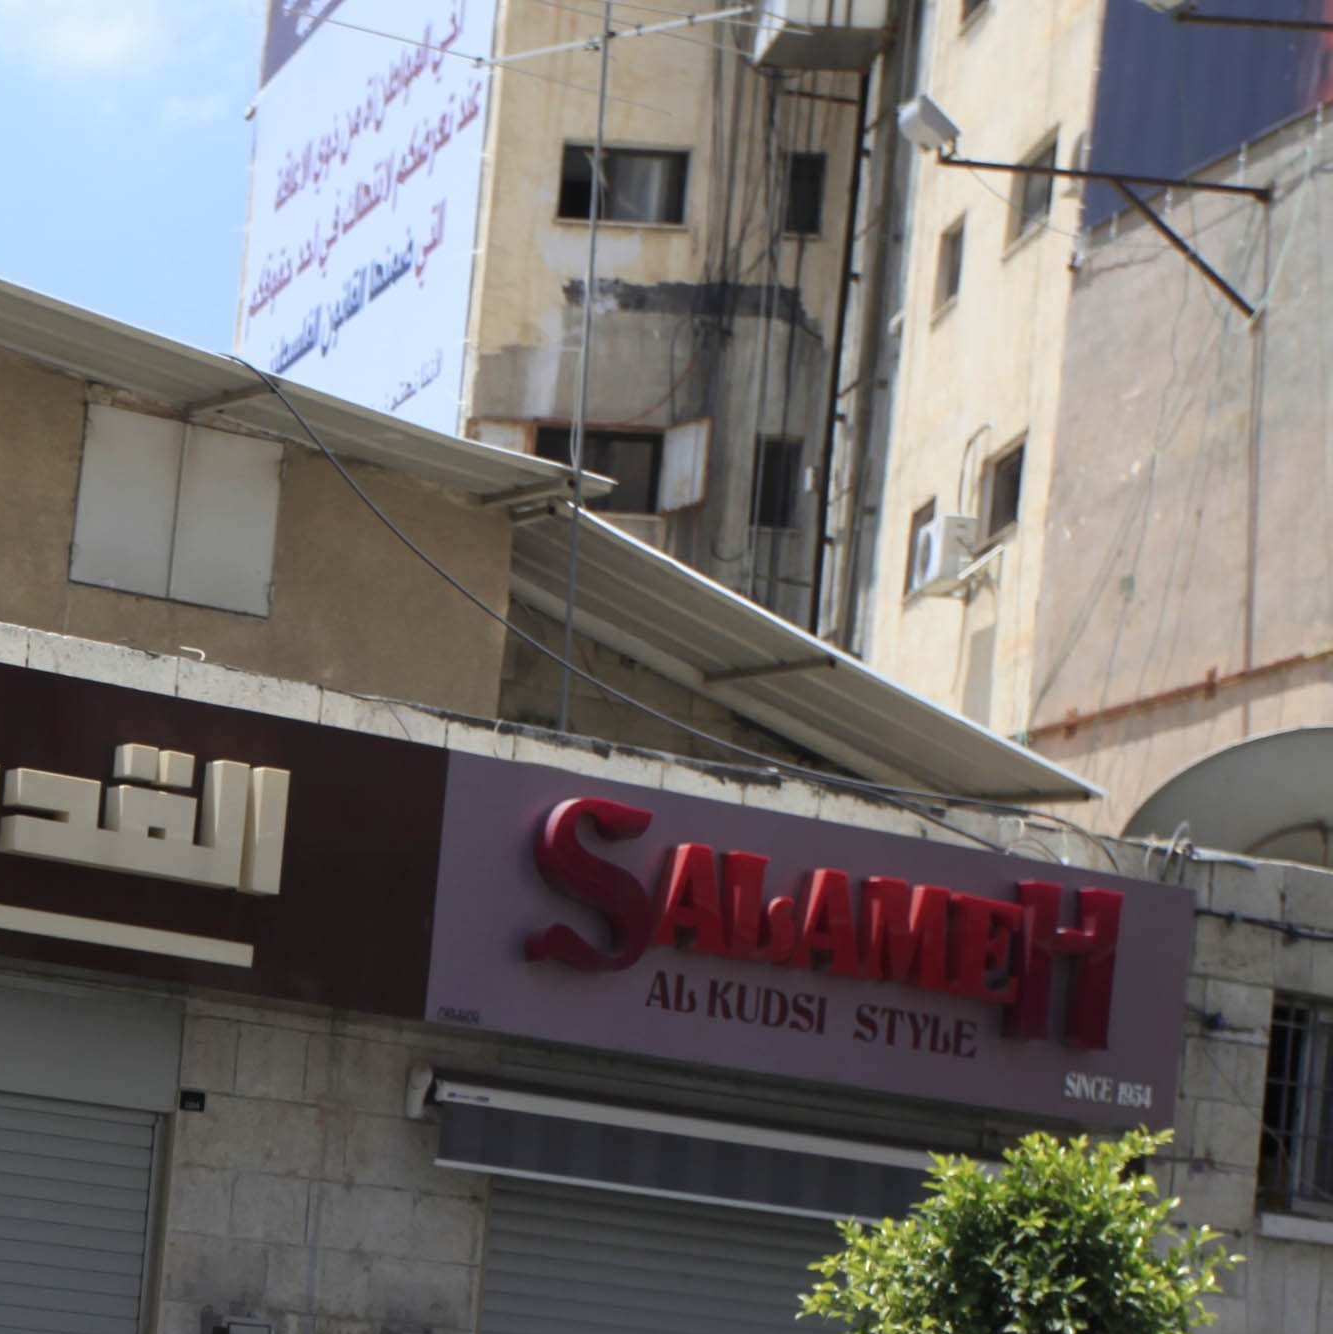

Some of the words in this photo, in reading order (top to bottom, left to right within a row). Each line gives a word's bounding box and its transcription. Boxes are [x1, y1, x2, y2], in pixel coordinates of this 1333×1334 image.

[523, 796, 1126, 1051] SALAMEH
[645, 968, 697, 1014] AL
[706, 977, 829, 1036] KUDSI
[852, 1001, 979, 1060] STYLE
[1063, 1070, 1113, 1104] SINCE
